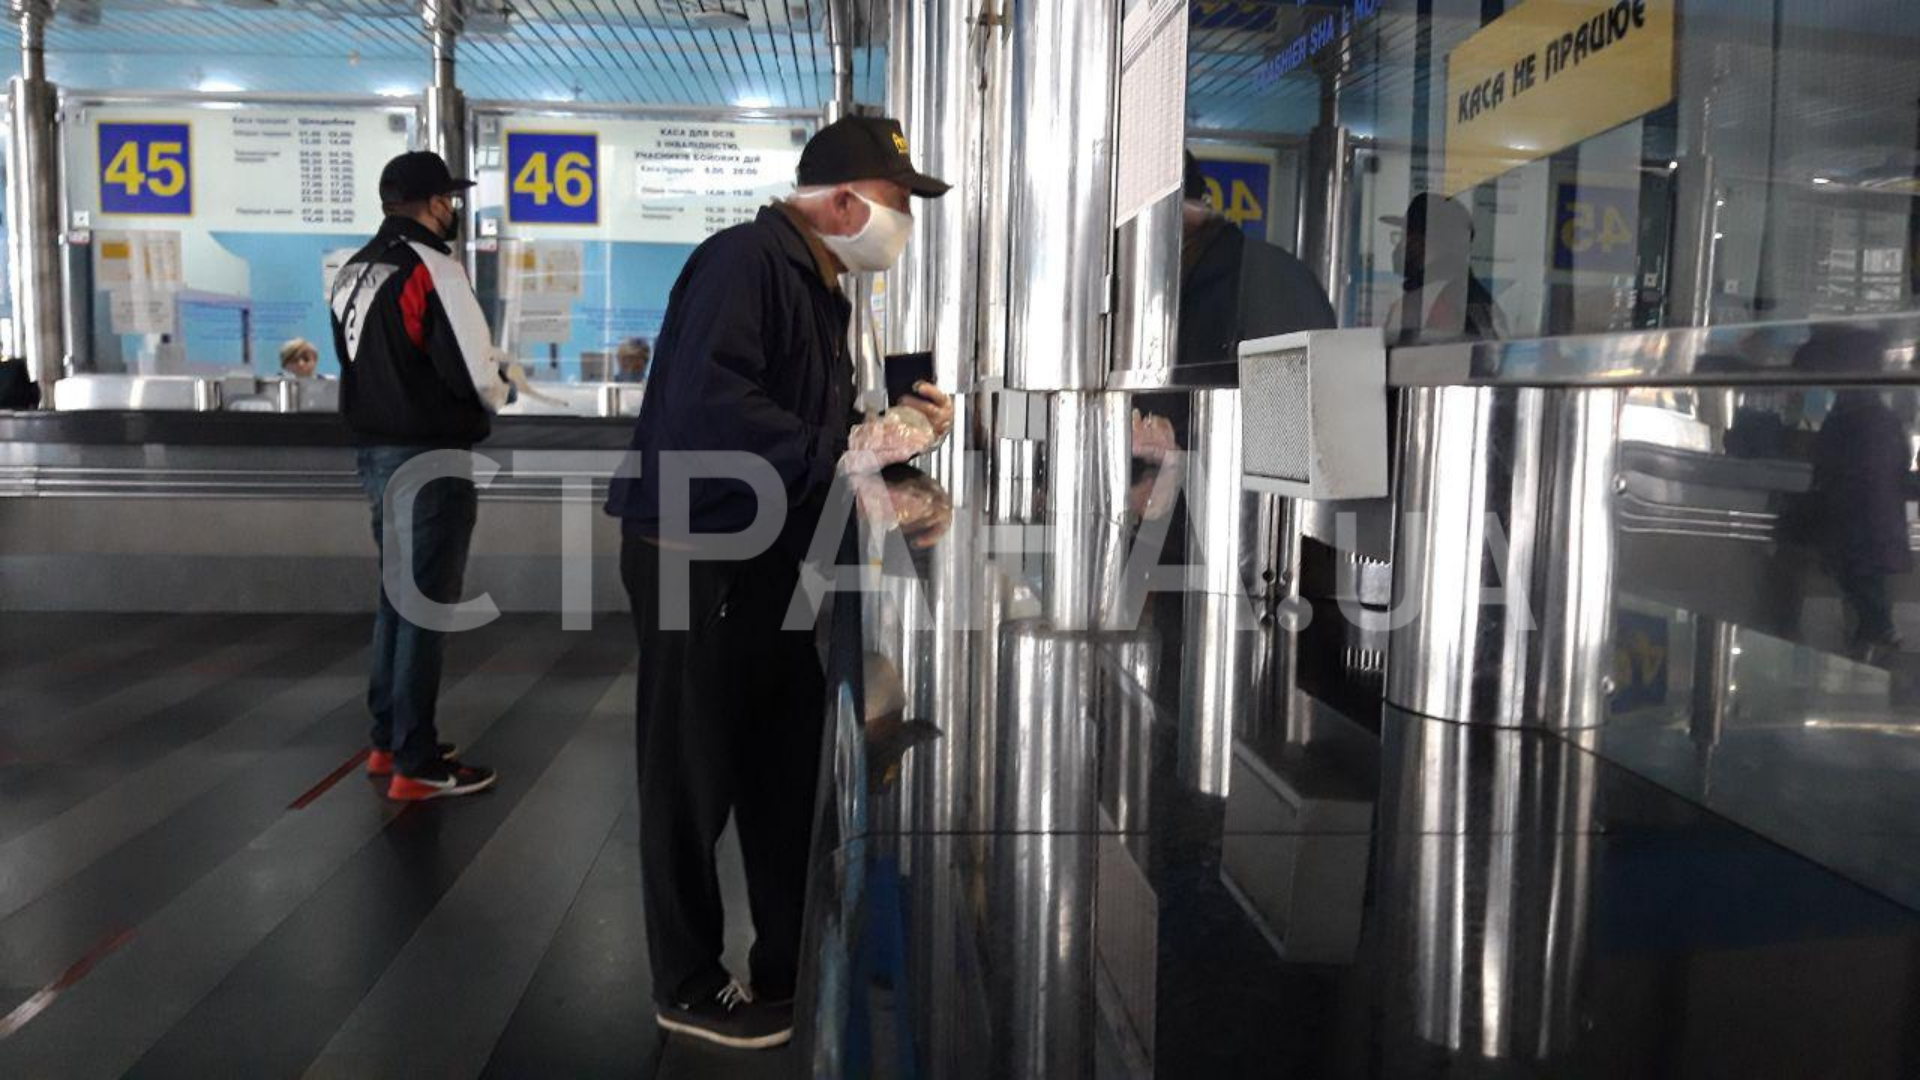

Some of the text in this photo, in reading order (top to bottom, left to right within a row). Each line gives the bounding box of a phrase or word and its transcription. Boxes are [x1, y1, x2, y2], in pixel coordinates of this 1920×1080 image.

[1457, 0, 1646, 124] КАСА НЕ ПРАЦЮЄ
[104, 140, 187, 197] 45
[513, 151, 593, 207] 46
